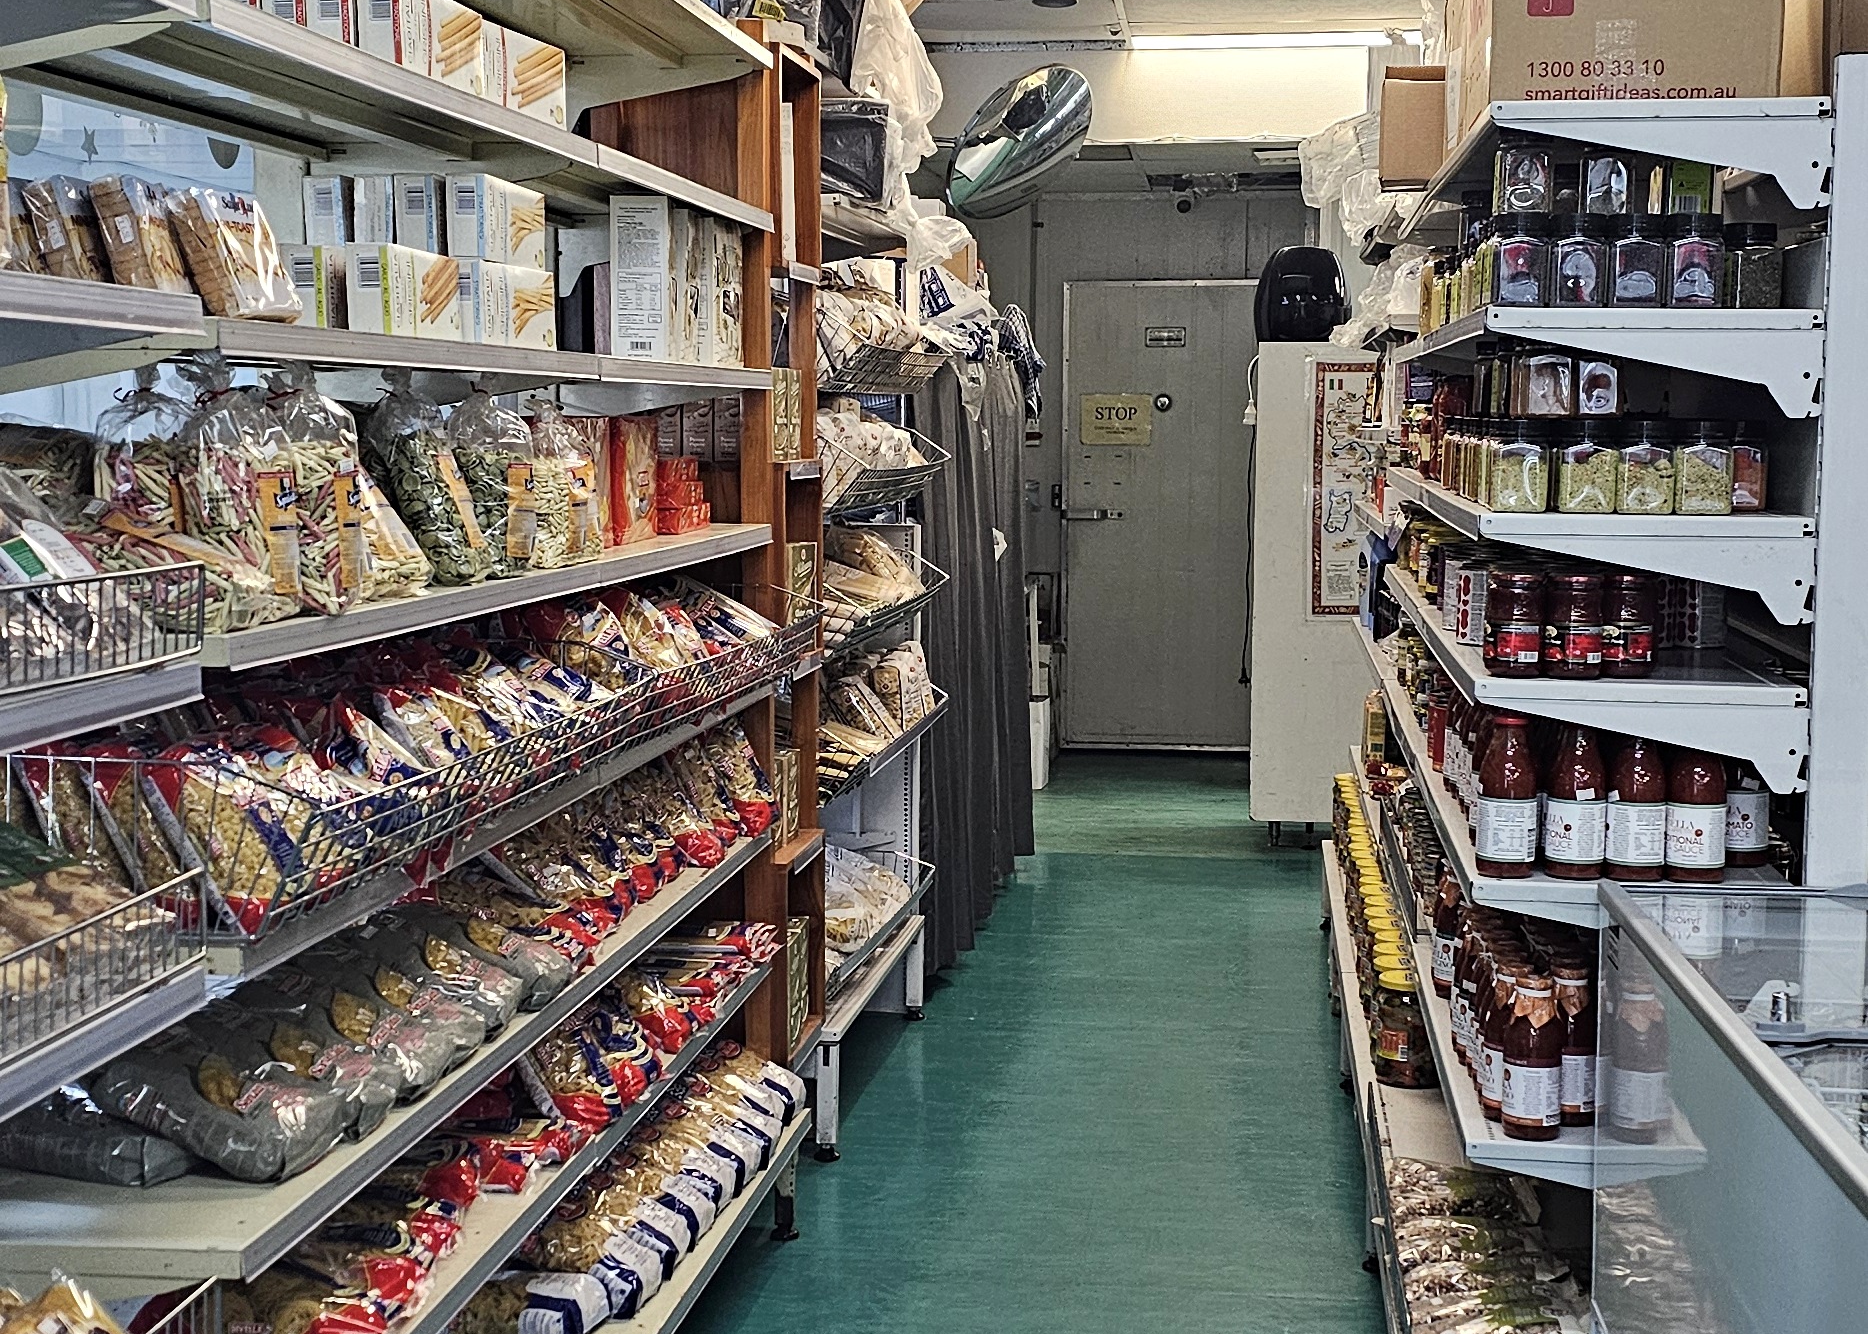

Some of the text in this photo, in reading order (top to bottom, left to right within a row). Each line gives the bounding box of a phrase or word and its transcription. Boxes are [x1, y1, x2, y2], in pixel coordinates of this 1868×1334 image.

[342, 1, 350, 42] TRADITIONAL
[1526, 58, 1665, 78] 1300 80 33 10
[1524, 83, 1737, 101] smartgiftideas.com.au
[1095, 406, 1138, 421] STOP
[1673, 845, 1704, 855] SAUCE
